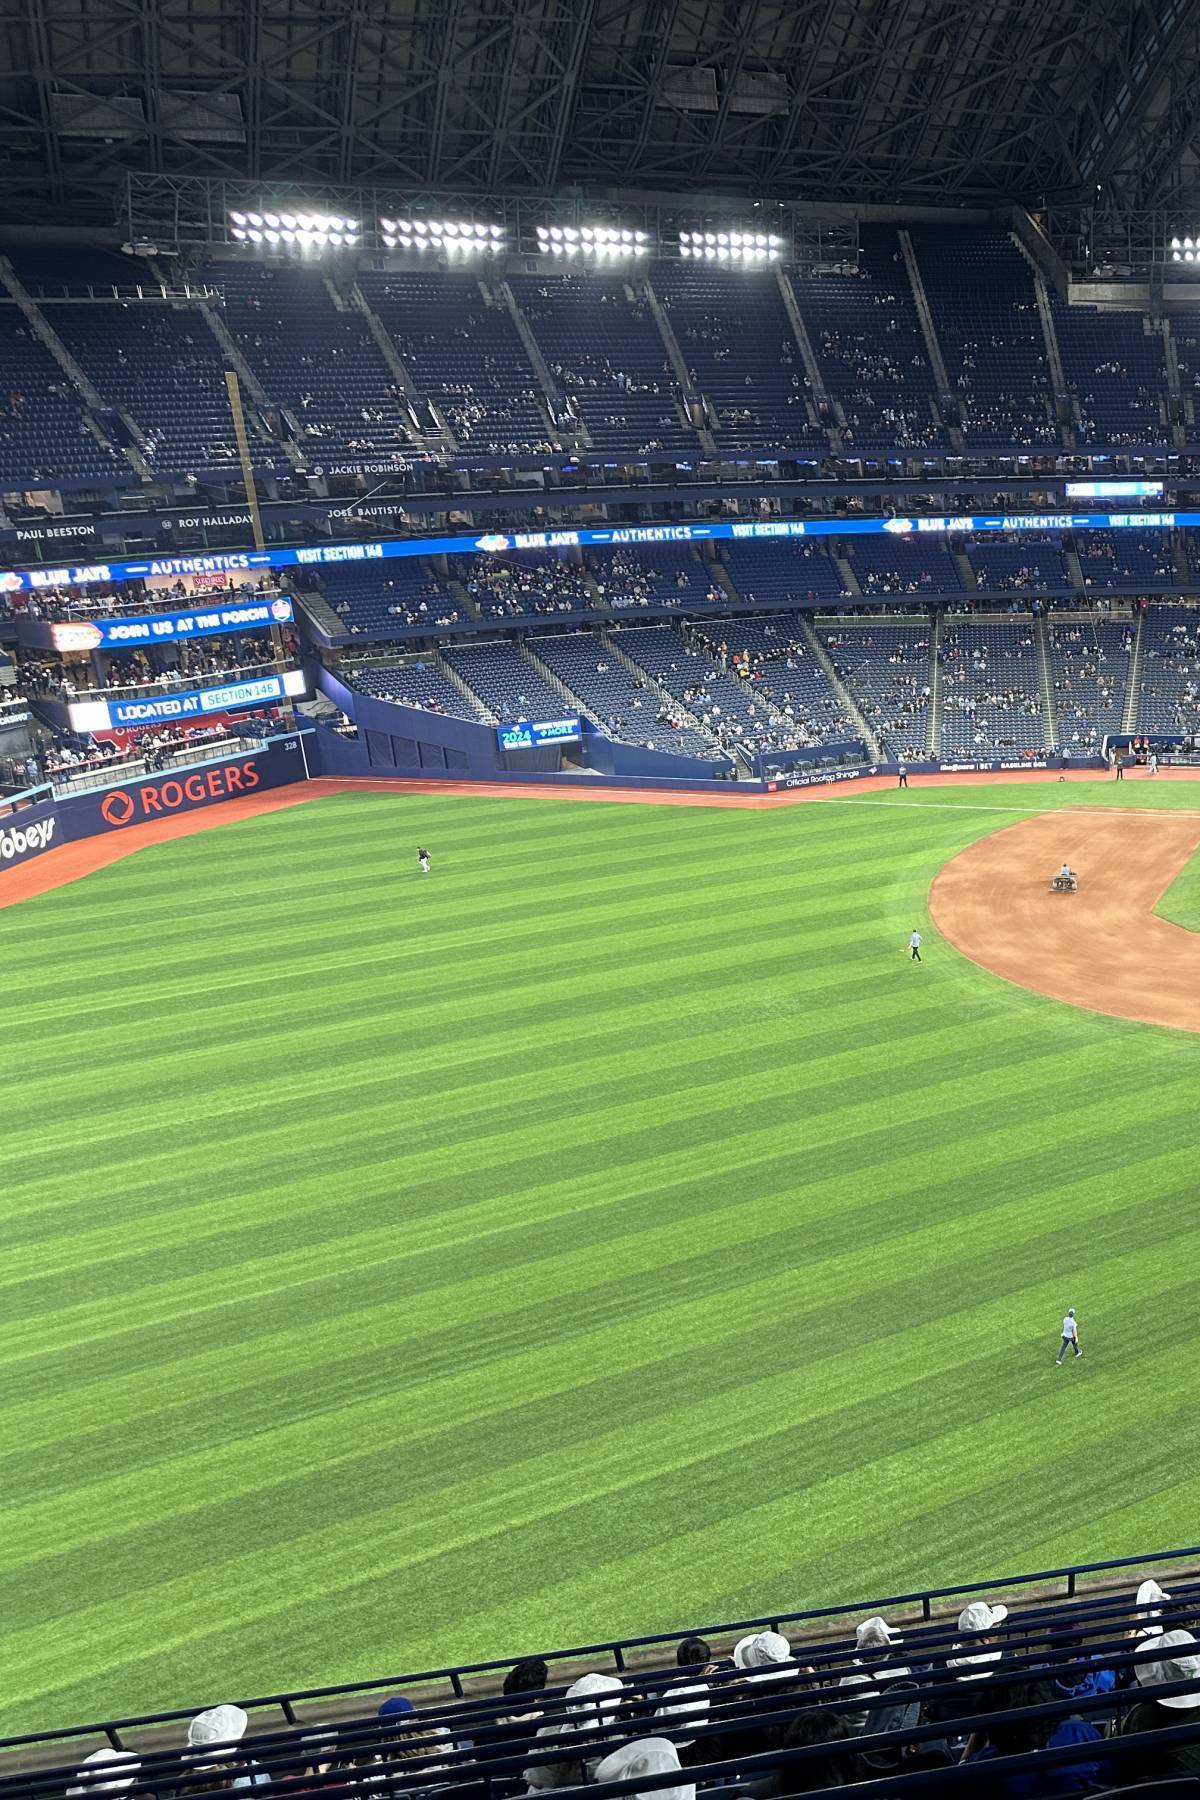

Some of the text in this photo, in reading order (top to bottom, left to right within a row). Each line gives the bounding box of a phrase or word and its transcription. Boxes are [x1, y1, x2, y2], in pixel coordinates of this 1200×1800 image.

[329, 465, 362, 475] JACKIE
[364, 463, 413, 473] ROBINSON
[357, 506, 405, 516] BAUTISTA
[178, 514, 254, 528] ROY HALLADAY
[918, 518, 973, 531] BLUE JAYS
[1002, 517, 1072, 528] AUTHENTICS
[1109, 515, 1129, 526] VISIT
[1129, 514, 1161, 526] SECTION
[16, 526, 95, 540] PAUL BEESTON
[611, 527, 692, 542] AUTHENTICS
[732, 525, 754, 537] VISIT
[755, 523, 789, 535] SECTION
[514, 531, 579, 549] BLUE JAYS
[296, 548, 322, 563] VISIT
[323, 545, 365, 560] SECTION
[151, 554, 249, 575] AUTHENTICS
[30, 565, 111, 587] BLUE JAYS
[108, 623, 150, 640] JOIN
[152, 620, 174, 635] US
[176, 618, 194, 632] AT
[195, 612, 220, 629] THE
[221, 606, 269, 625] PORCH!
[116, 683, 274, 721] LOCATED AT SECTION 146
[126, 721, 162, 734] ROGERS
[502, 730, 531, 743] 2024
[284, 741, 297, 751] 328
[980, 762, 993, 770] BET
[1001, 761, 1032, 769] BASELINE
[786, 776, 810, 787] Official
[836, 770, 860, 780] Shingle
[140, 761, 260, 815] ROGERS
[0, 816, 55, 860] obeys
